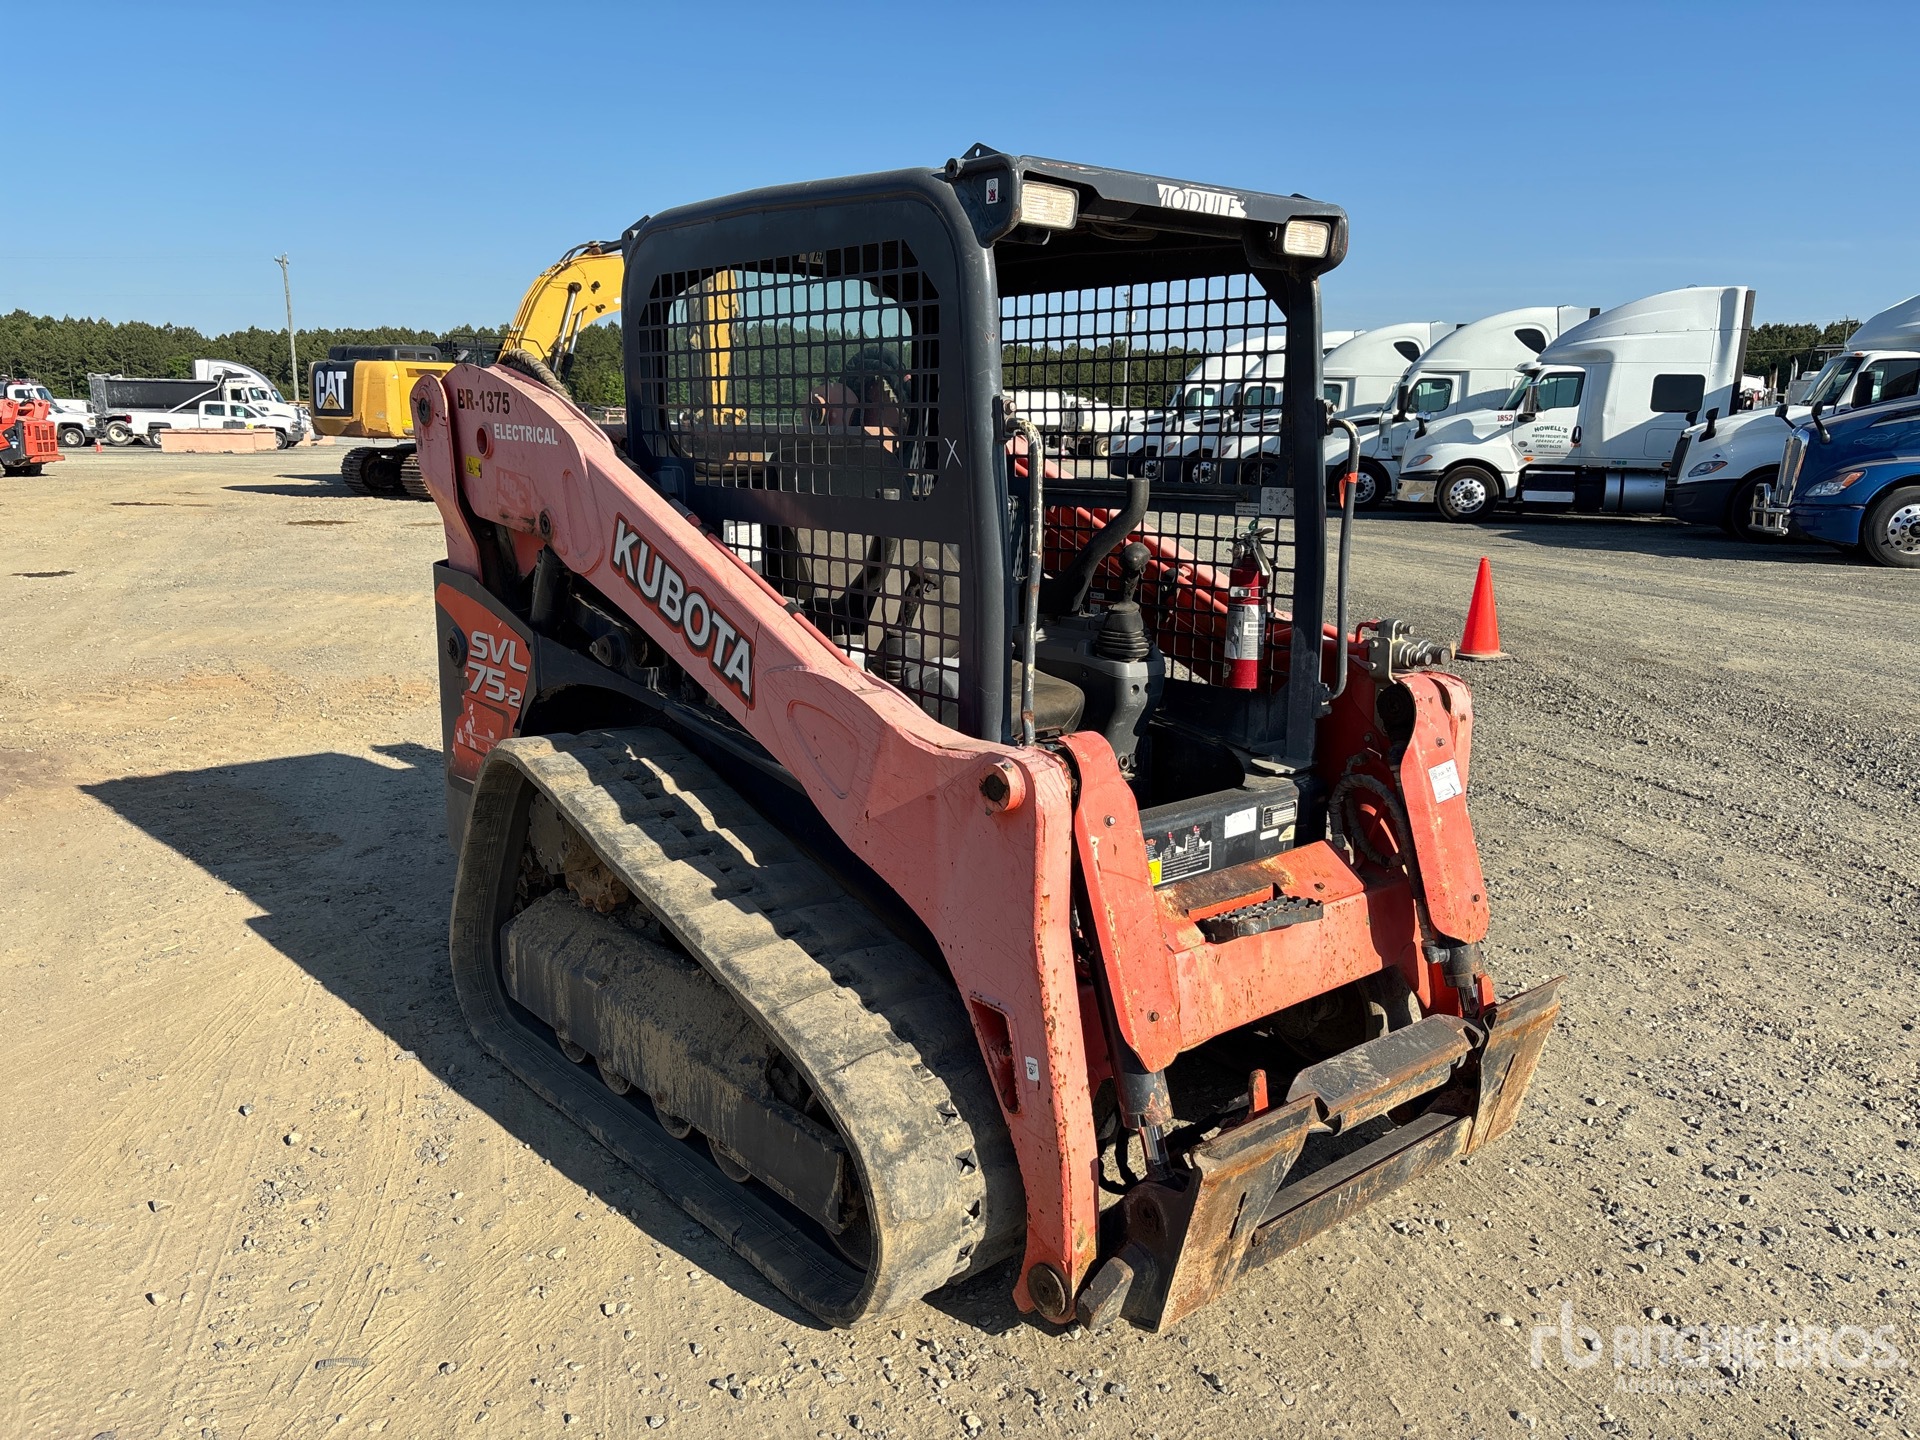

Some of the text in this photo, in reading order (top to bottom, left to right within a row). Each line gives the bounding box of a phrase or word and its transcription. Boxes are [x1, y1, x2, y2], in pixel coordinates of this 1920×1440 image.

[315, 370, 348, 410] CAT
[456, 388, 511, 415] BR-1375
[1496, 414, 1514, 422] 1852
[1534, 425, 1569, 434] HOWELL'S
[493, 422, 559, 446] ELECTRICAL
[613, 518, 751, 697] KUBOTA
[469, 630, 528, 673] SVL
